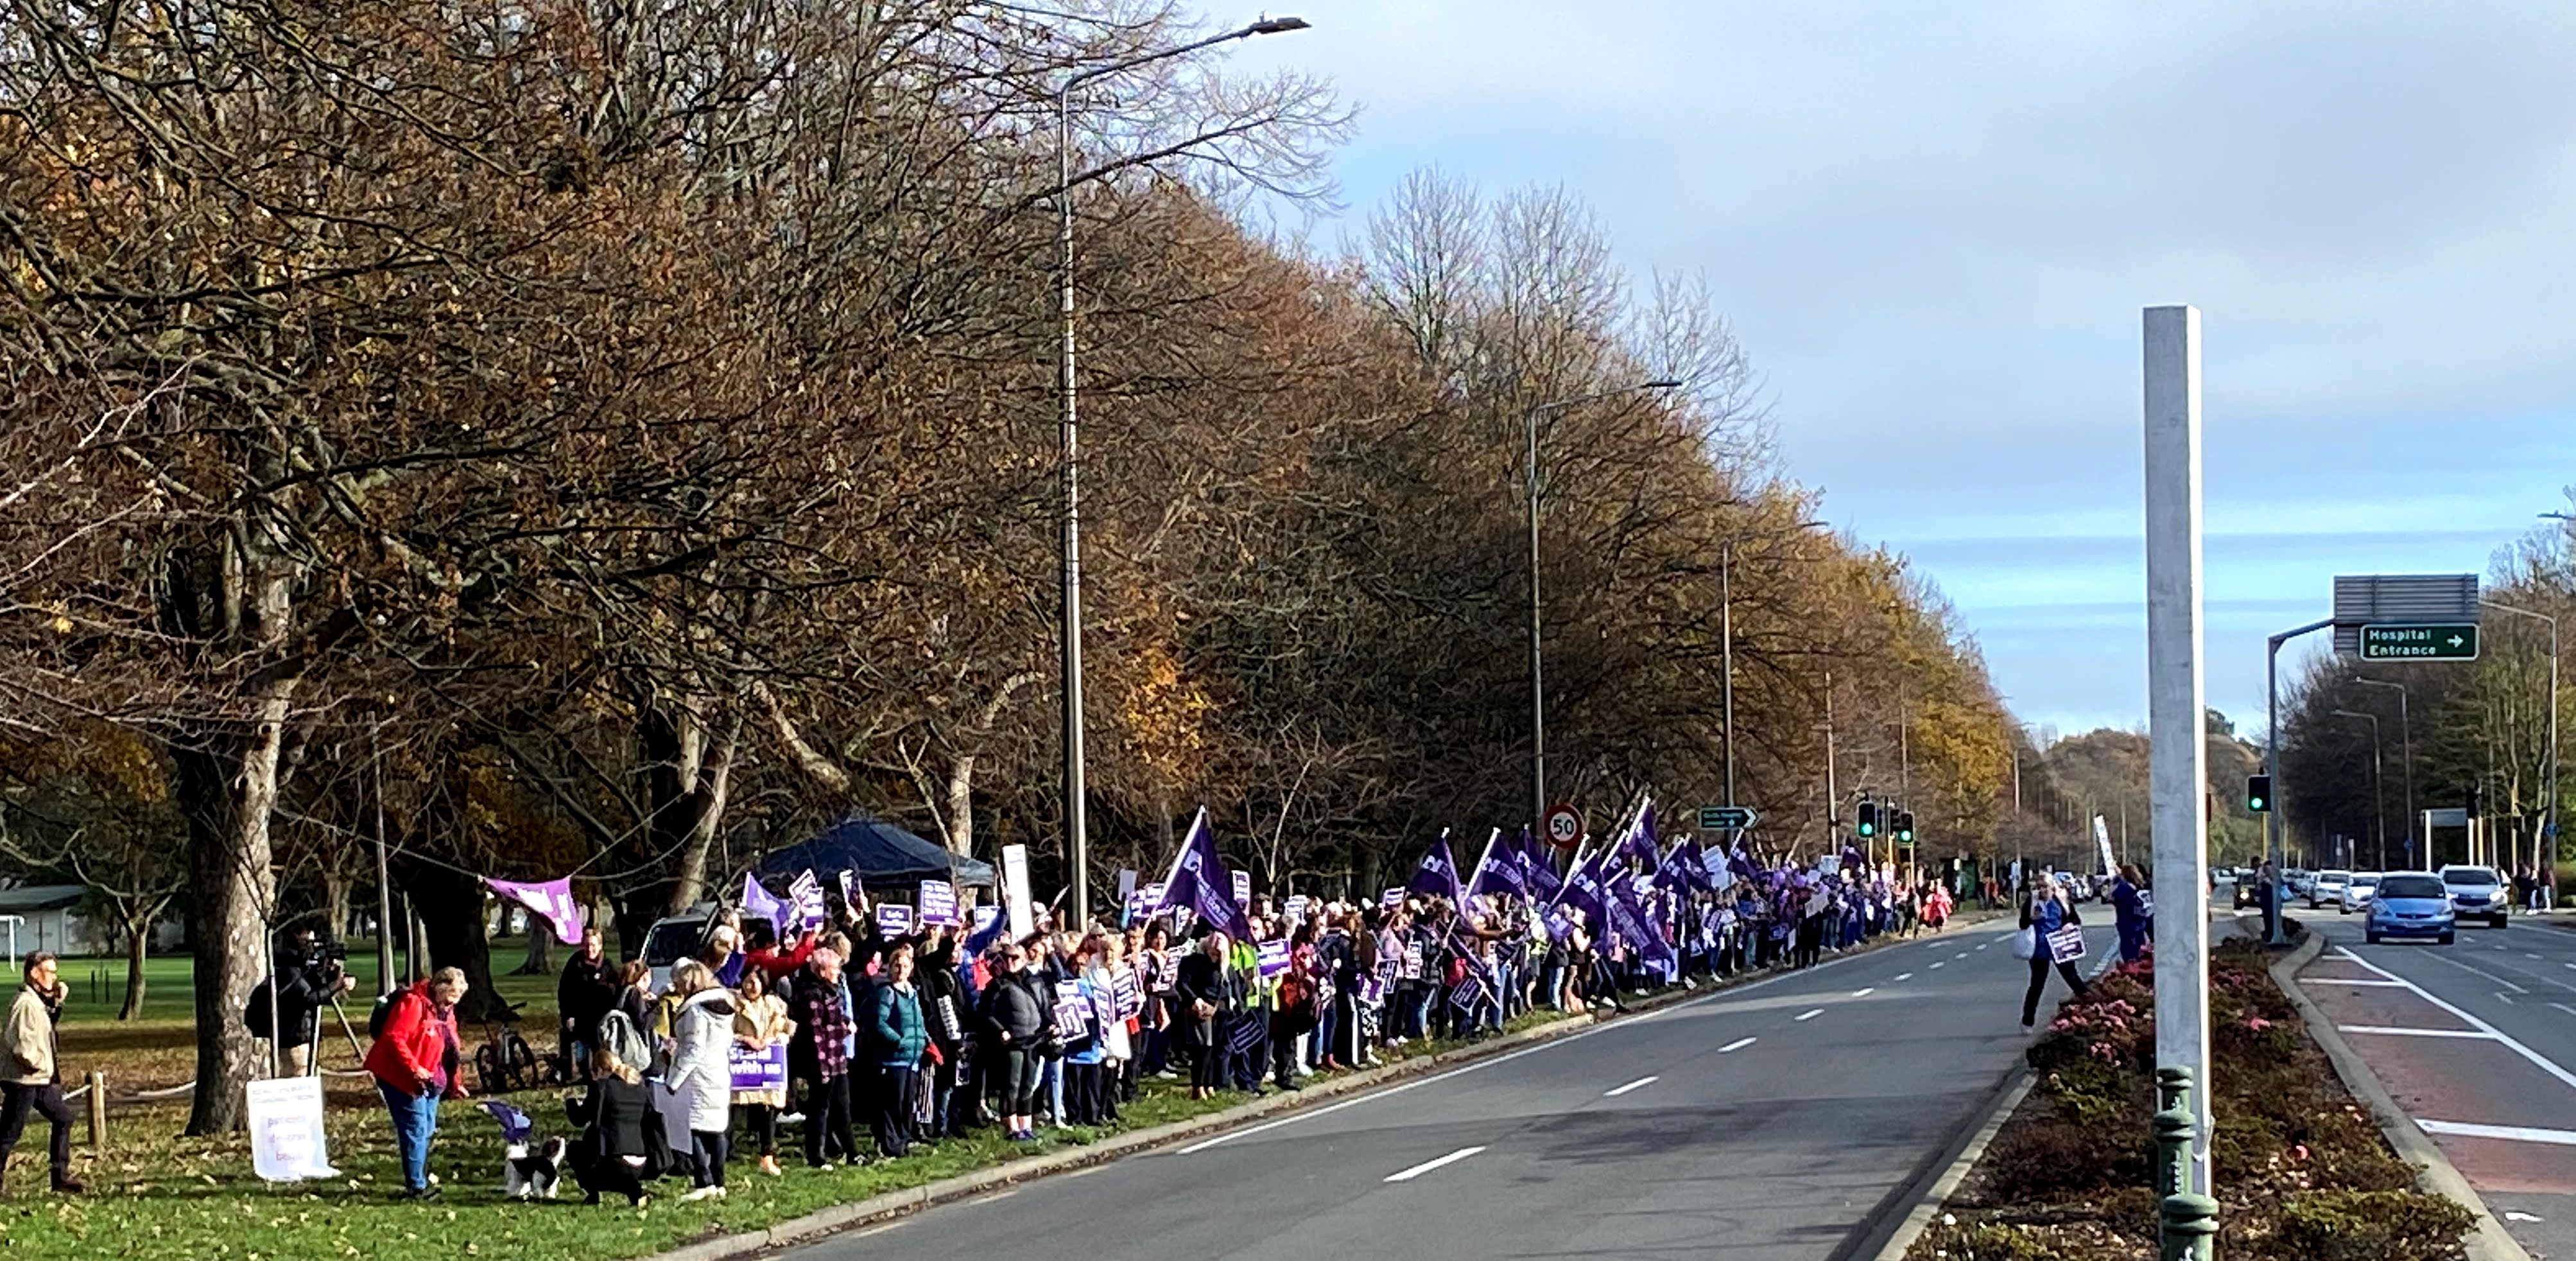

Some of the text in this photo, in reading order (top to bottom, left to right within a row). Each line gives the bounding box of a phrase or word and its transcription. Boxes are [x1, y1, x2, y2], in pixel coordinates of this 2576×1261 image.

[2369, 629, 2431, 641] Hospital
[2369, 645, 2436, 656] Entrance
[1553, 819, 1574, 835] 50
[729, 1060, 781, 1074] with us
